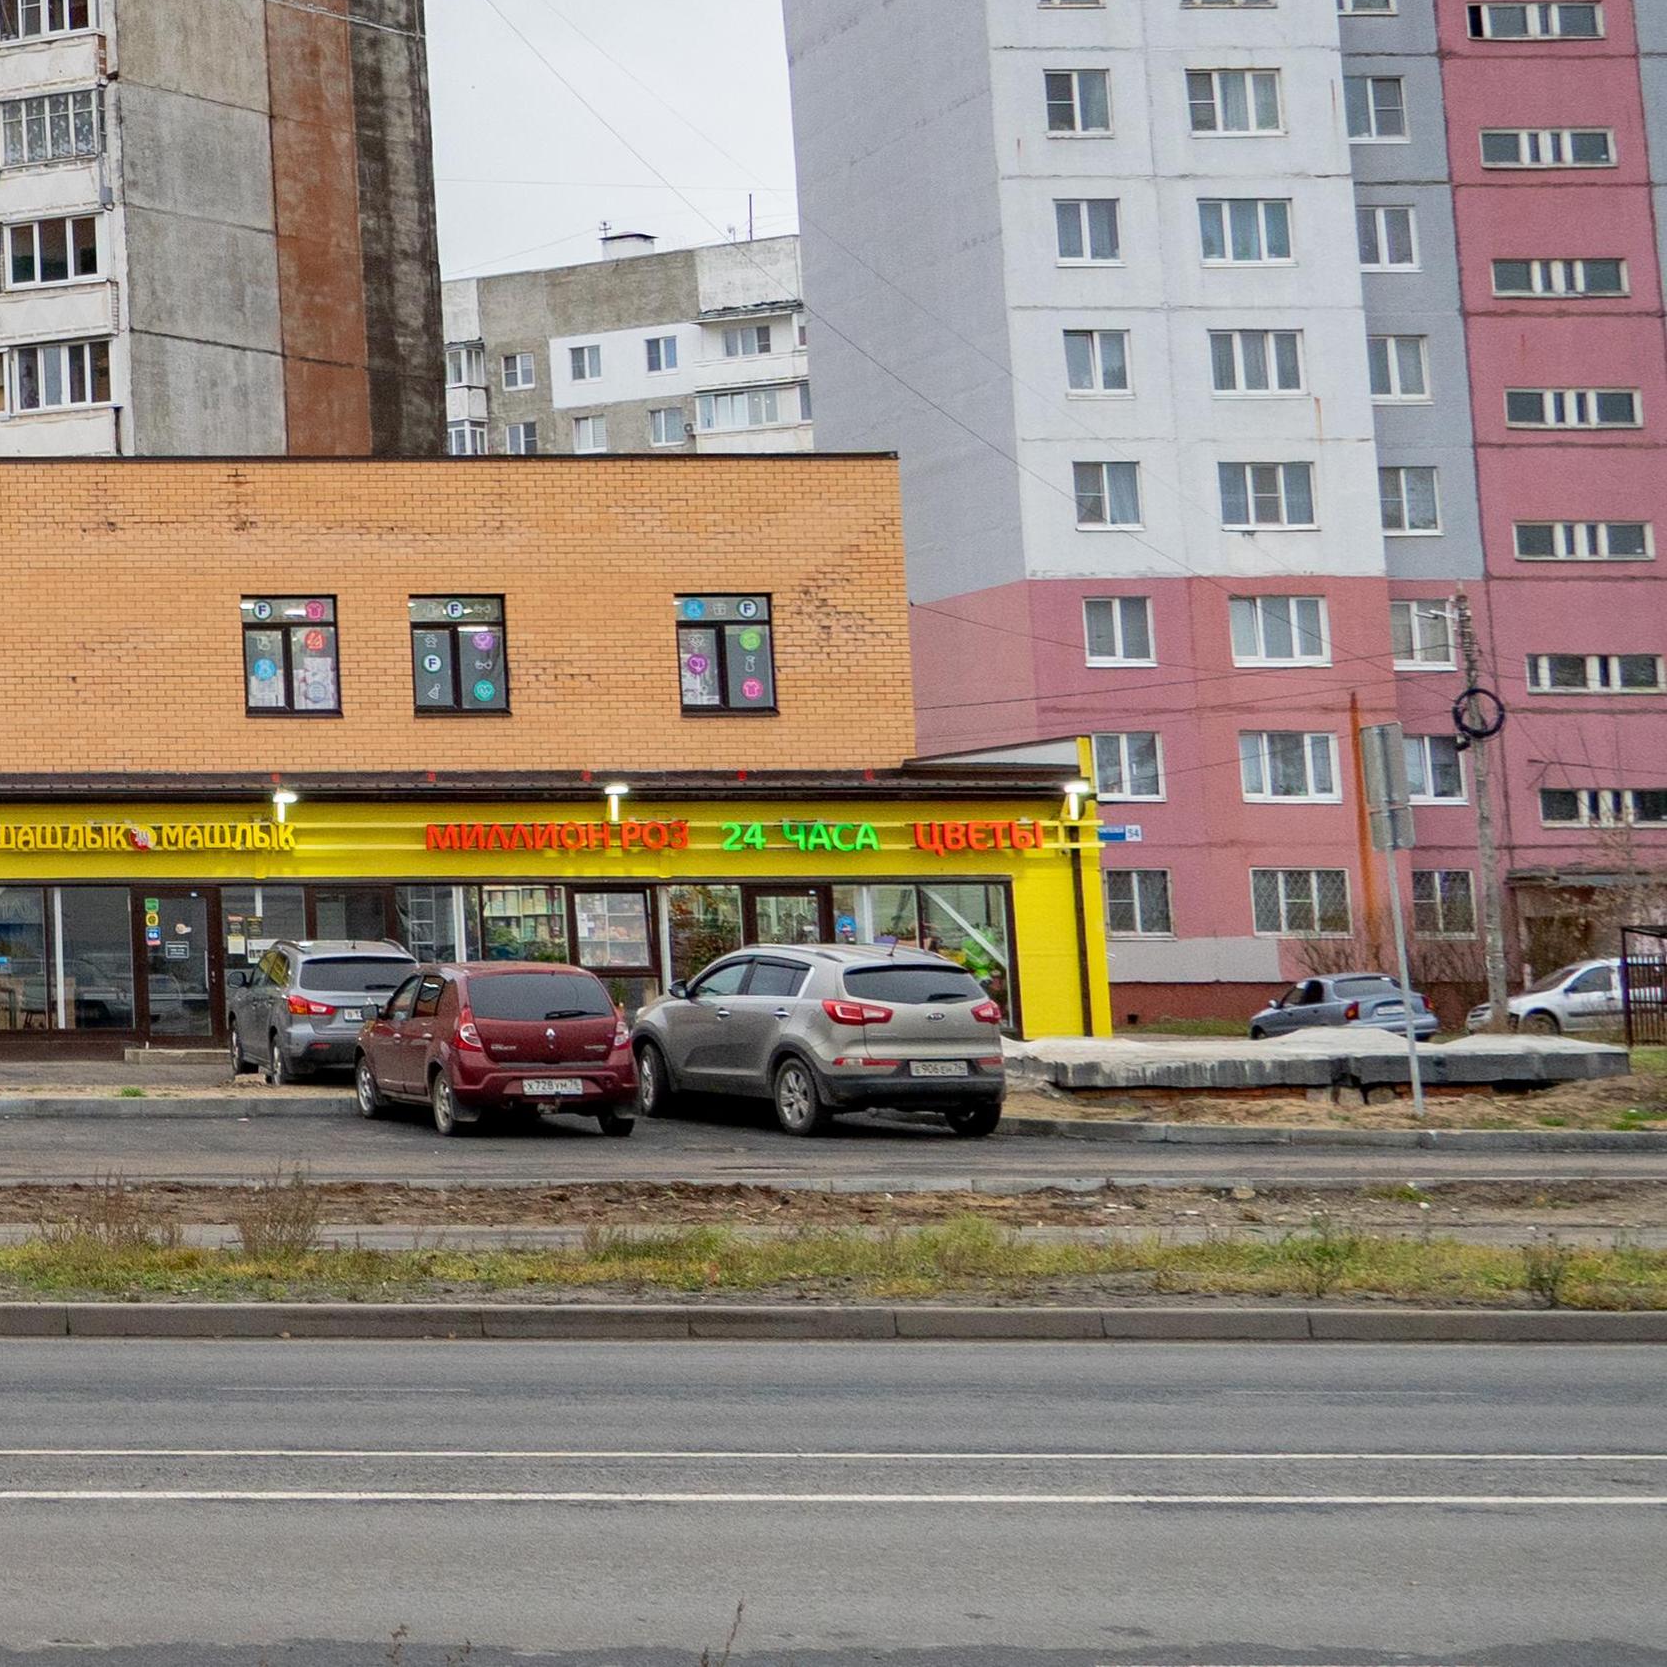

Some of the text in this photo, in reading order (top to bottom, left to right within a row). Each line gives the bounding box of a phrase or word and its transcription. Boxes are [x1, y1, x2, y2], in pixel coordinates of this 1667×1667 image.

[161, 824, 296, 850] МАШЛЫК
[426, 820, 690, 850] МИЛЛИОН РОЗ
[721, 819, 881, 852] 24 ЧАСА
[913, 820, 1044, 856] ЦВЕТЫ
